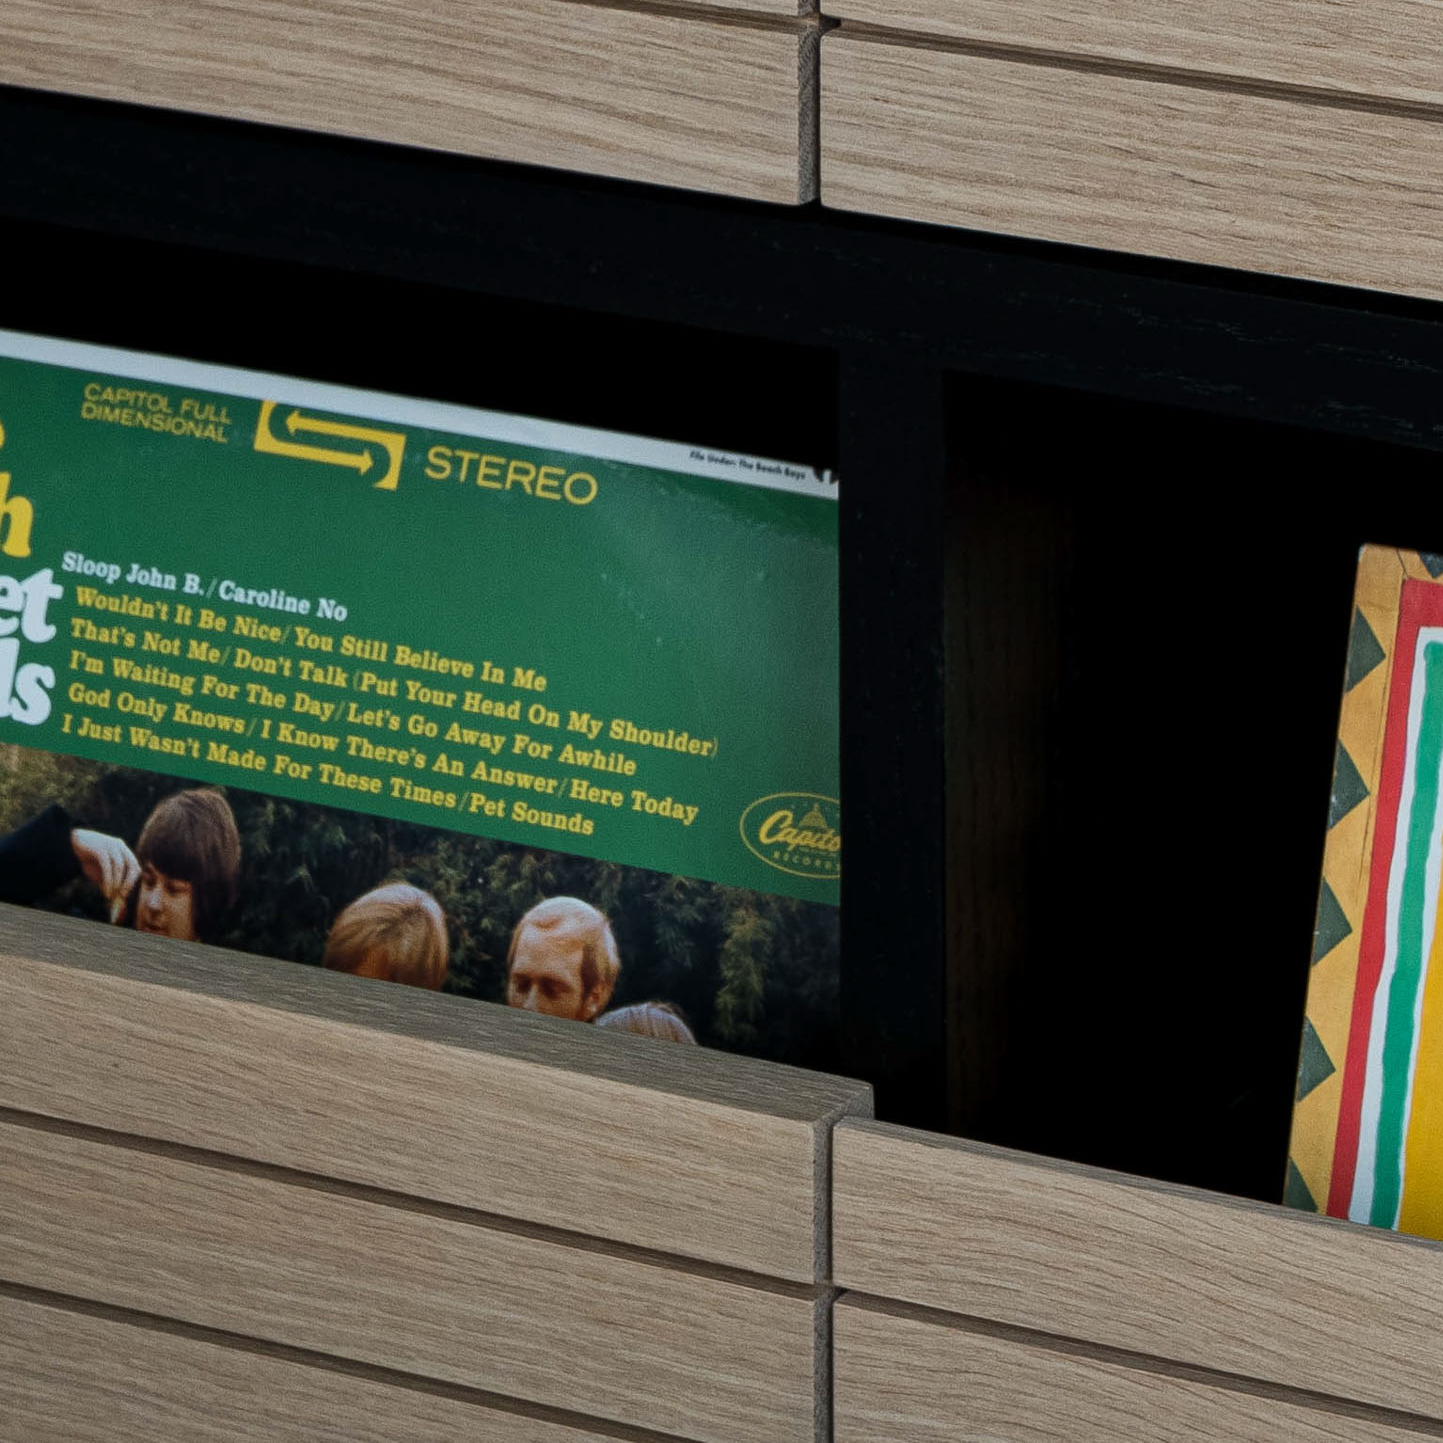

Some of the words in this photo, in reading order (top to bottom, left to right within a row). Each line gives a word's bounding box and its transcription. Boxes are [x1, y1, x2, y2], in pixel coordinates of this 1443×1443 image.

[80, 401, 229, 444] DIMENSIONAL
[84, 382, 173, 414] CAPITOL
[180, 398, 231, 424] FULL
[424, 445, 599, 506] STEREO
[61, 550, 121, 584] Sloop
[126, 562, 177, 591] John
[315, 597, 348, 622] No
[76, 585, 169, 621] Wouldn't
[174, 603, 193, 626] It
[197, 608, 227, 632] Be
[340, 634, 388, 662] Still
[394, 645, 475, 678] Believe
[480, 661, 505, 684] In
[511, 667, 547, 692] Me
[69, 649, 104, 675] I'm
[112, 656, 196, 696] Waiting
[200, 674, 240, 700] For
[246, 683, 287, 709] The
[407, 714, 439, 738] Go
[444, 722, 506, 755] Away
[512, 733, 553, 760] For
[558, 743, 637, 776] Awhile
[71, 617, 136, 649] That's
[141, 630, 181, 656] Not
[299, 660, 349, 688] Talk
[405, 679, 457, 708] Your
[462, 690, 521, 720] Head
[527, 703, 560, 728] On
[566, 710, 604, 740] My
[61, 713, 73, 734] I
[77, 717, 123, 743] Just
[128, 726, 201, 759] Wasn't
[206, 741, 267, 770] Made
[272, 754, 313, 780] For
[318, 762, 383, 795] These
[511, 801, 595, 836] Sounds
[68, 682, 111, 709] God
[117, 691, 168, 723] Only
[276, 721, 340, 752] Know
[346, 735, 427, 769] There's
[432, 752, 465, 777] An
[631, 789, 699, 826] Today
